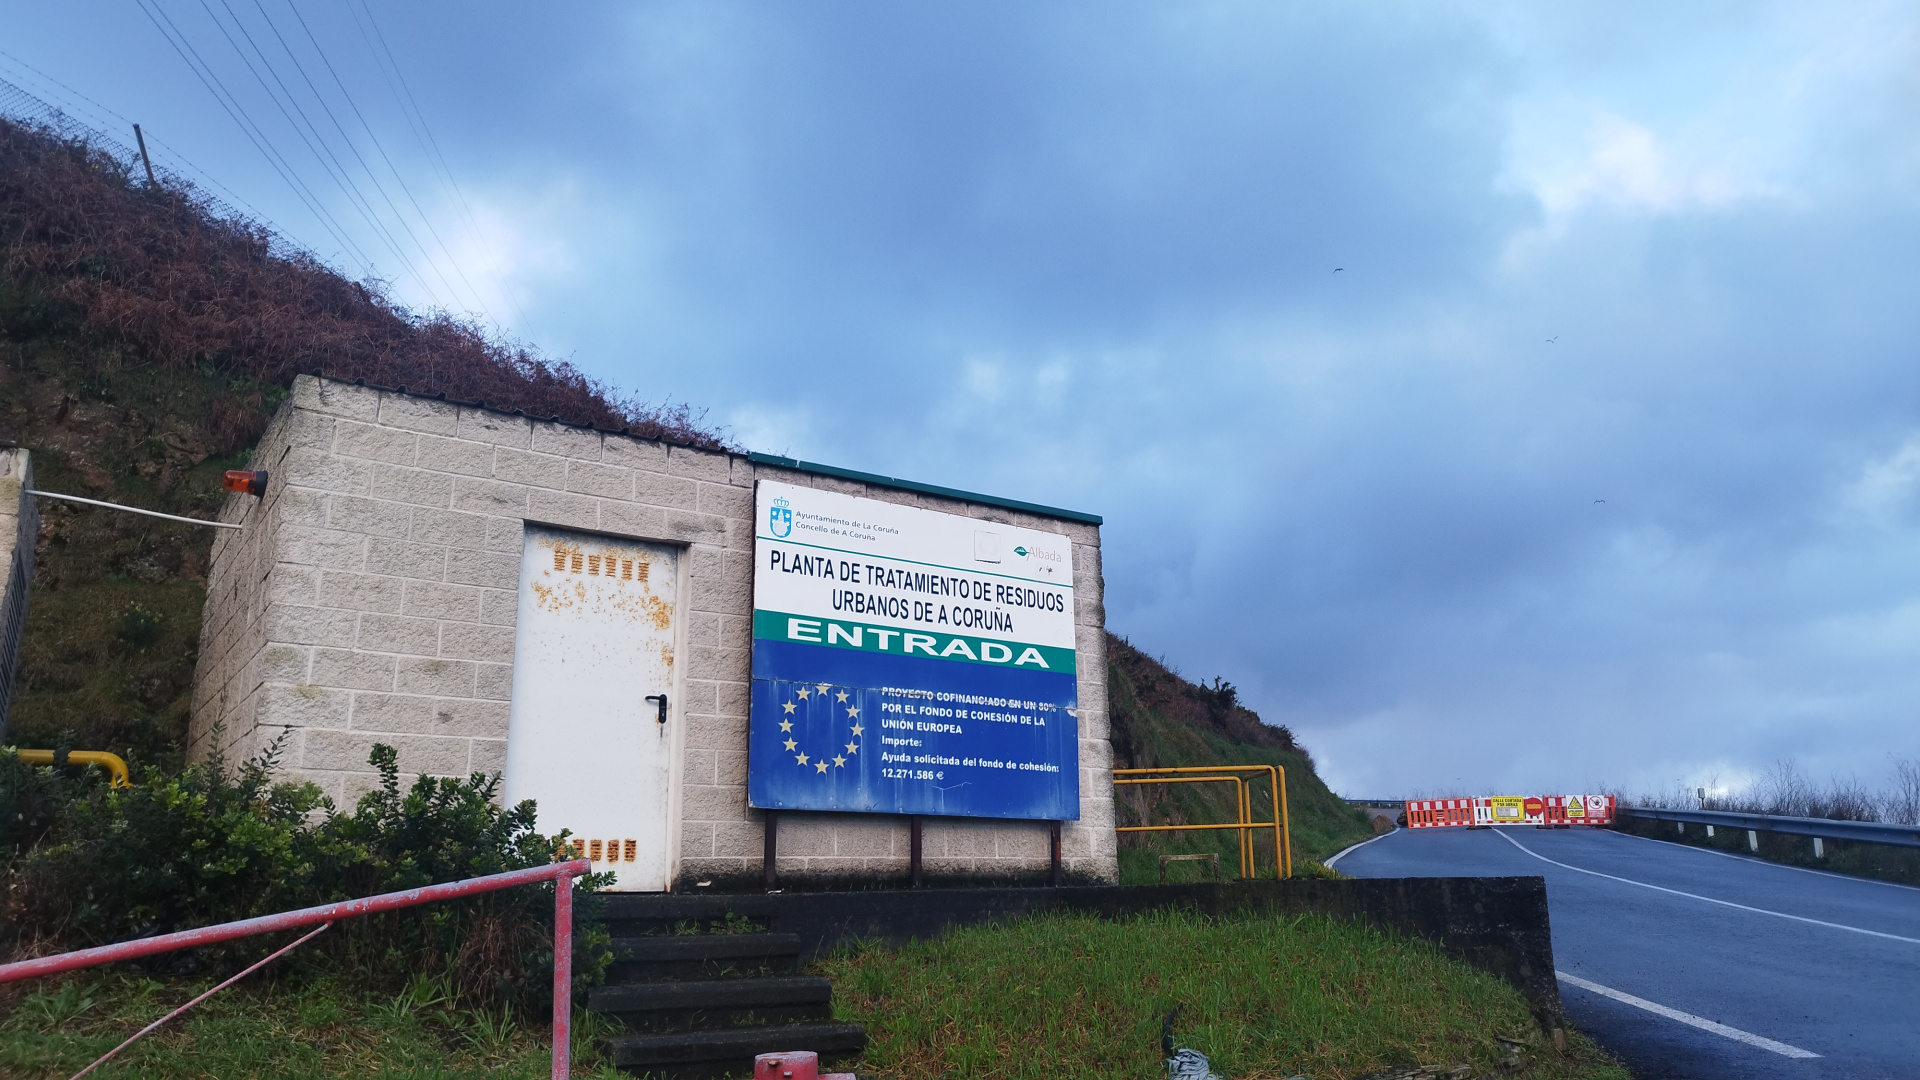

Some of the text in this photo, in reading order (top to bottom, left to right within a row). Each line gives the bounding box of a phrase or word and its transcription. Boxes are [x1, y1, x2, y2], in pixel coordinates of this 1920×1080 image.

[795, 521, 828, 533] Concello
[830, 527, 840, 535] de
[849, 530, 876, 541] Coruña
[796, 510, 899, 535] Ayuntamiento de La Coruña
[1026, 546, 1062, 563] Albada
[770, 549, 1064, 613] PLANTA DE TRATAMIENTO DE RESIDUOS
[832, 588, 1014, 633] URBANOS DE A CORUÑA
[787, 618, 1050, 669] ENTRADA
[881, 686, 934, 701] PROYECTO
[936, 692, 1006, 708] COFINANCIADO
[1008, 699, 1021, 709] EN
[1023, 700, 1036, 710] UN
[881, 702, 1046, 727] POR EL FONDO DE COHESIÓN DE LA
[881, 718, 963, 734] UNIÓN EUROPEA
[881, 735, 922, 748] Importe:
[881, 751, 1060, 773] Ayuda solicitada del fondo de cohesión:
[881, 768, 945, 780] 12.271.586 €
